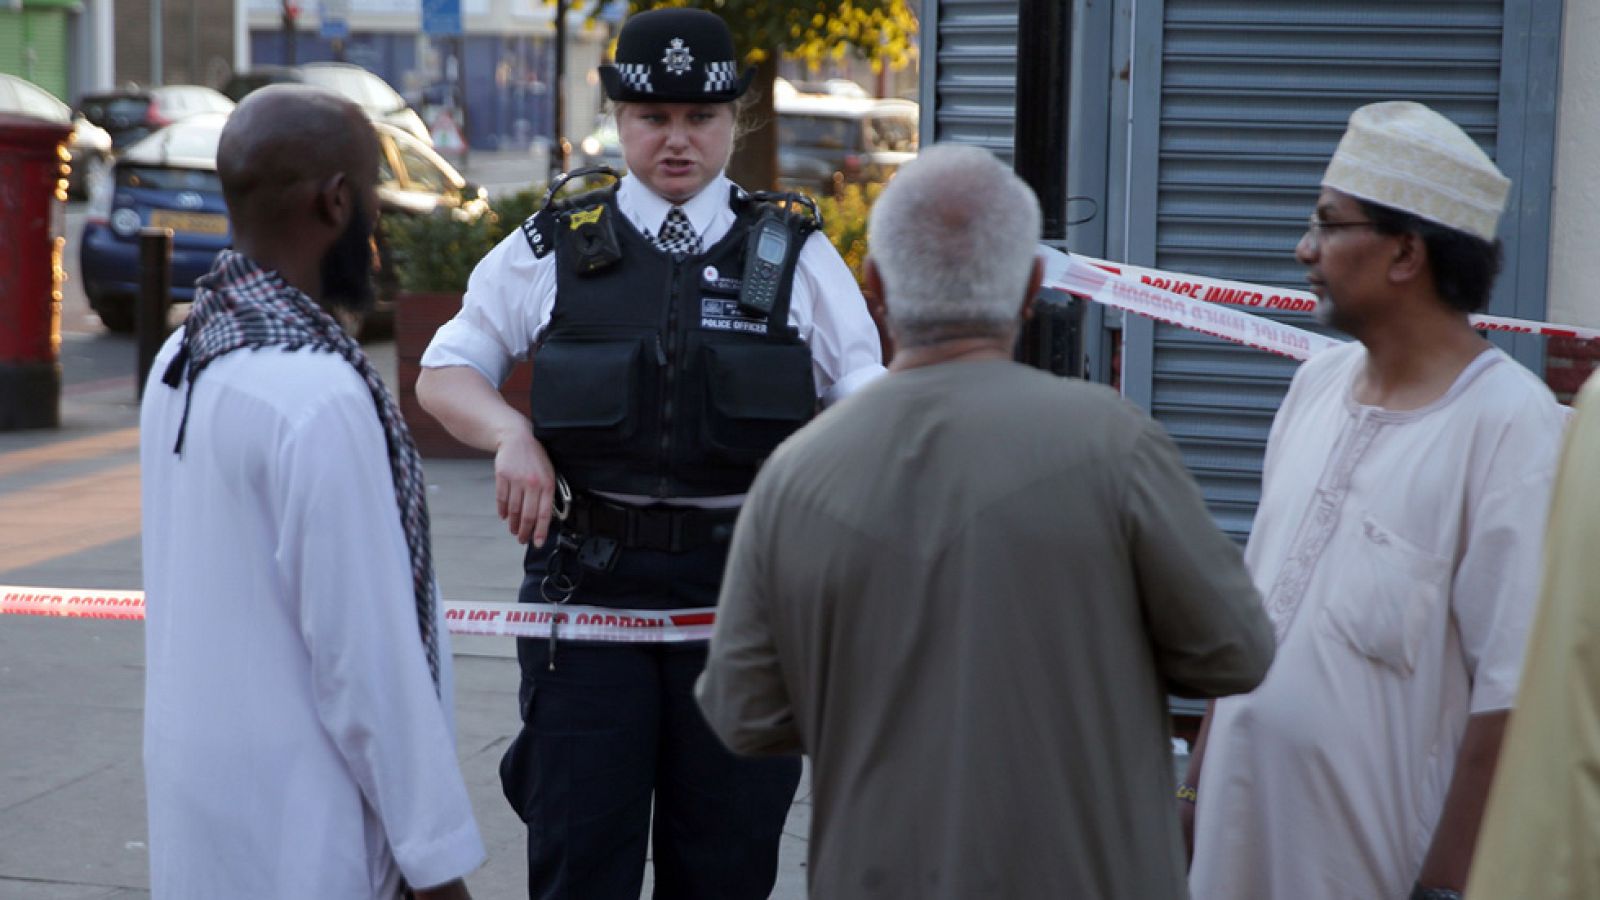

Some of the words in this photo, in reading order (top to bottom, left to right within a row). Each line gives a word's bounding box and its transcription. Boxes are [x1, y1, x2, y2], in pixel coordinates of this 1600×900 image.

[1264, 295, 1317, 312] CORD
[702, 318, 732, 329] POLICE
[733, 321, 767, 333] OFFICER
